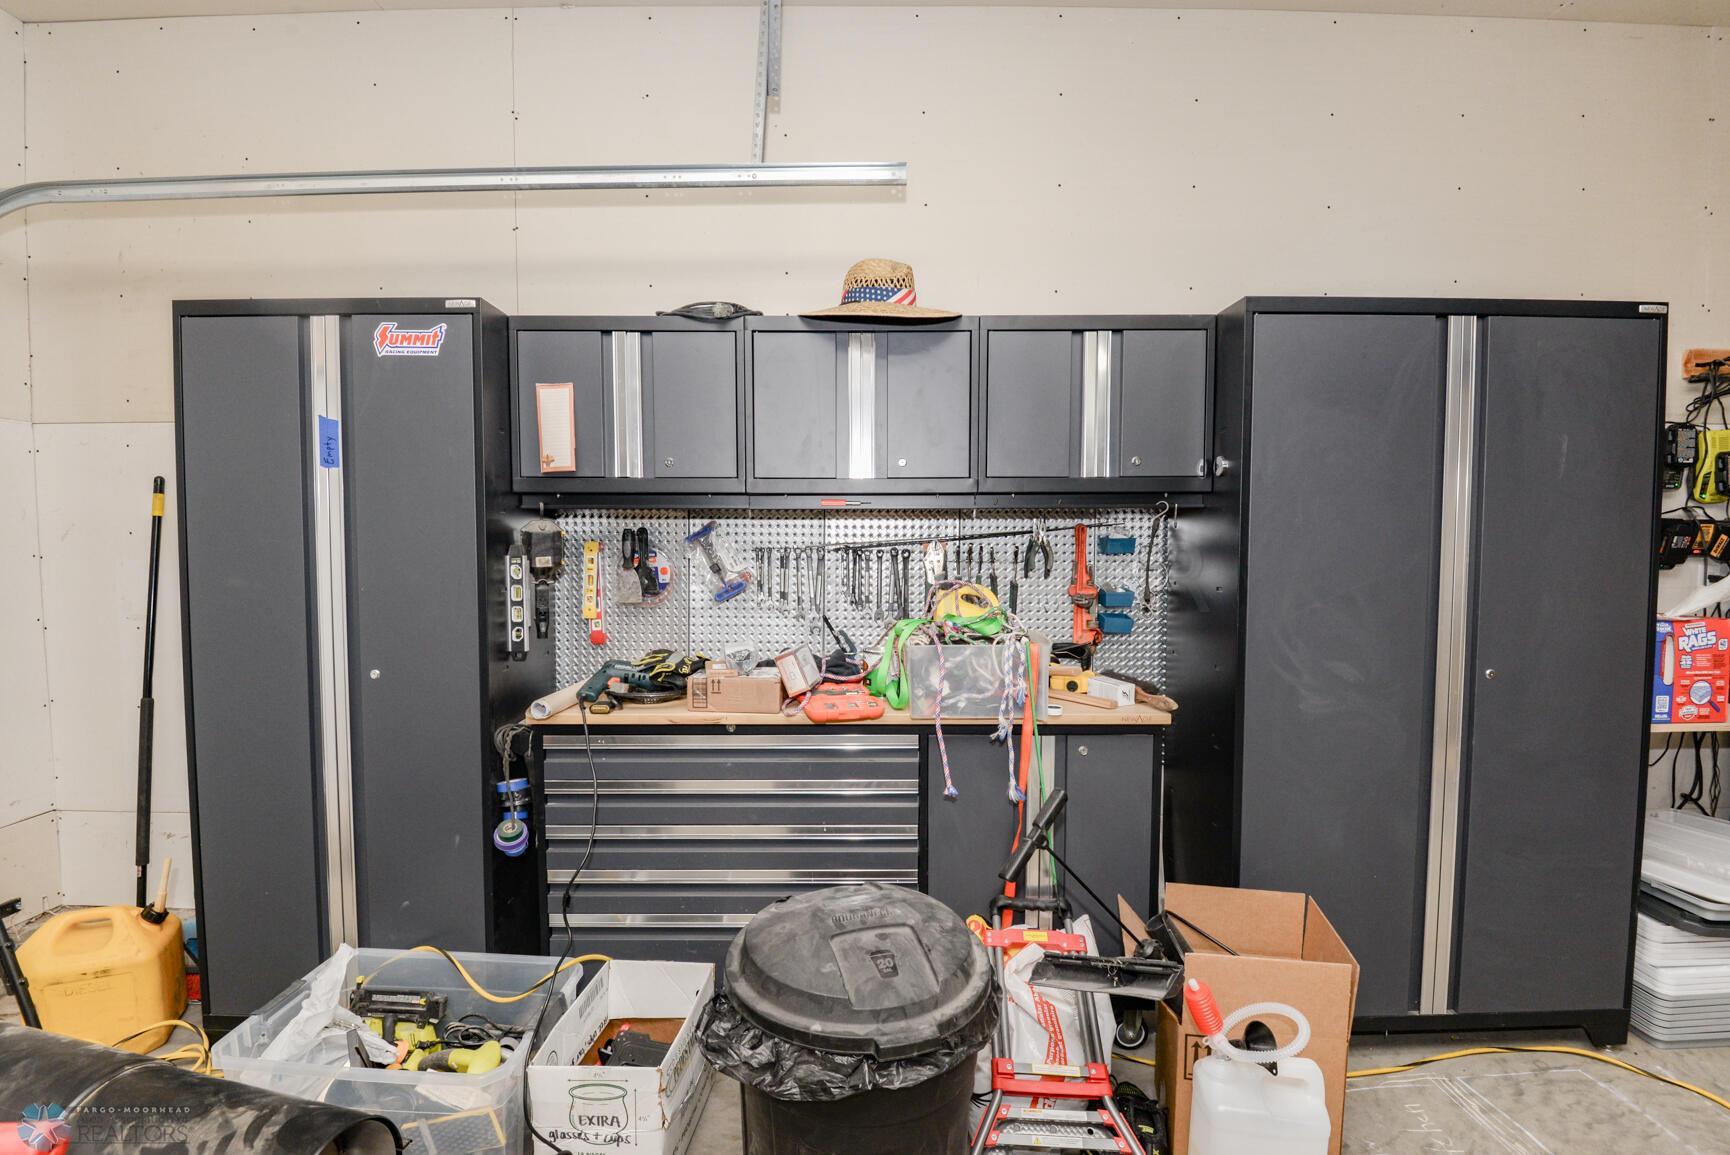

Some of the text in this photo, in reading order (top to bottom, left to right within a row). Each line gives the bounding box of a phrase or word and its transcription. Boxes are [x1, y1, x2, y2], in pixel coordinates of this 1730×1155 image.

[323, 436, 336, 465] Empty
[1682, 626, 1707, 636] WHITE
[1678, 631, 1717, 653] RAGS
[876, 957, 894, 970] 20
[578, 1114, 621, 1128] EXTRA
[549, 1129, 590, 1144] glasses
[603, 1134, 632, 1148] cups
